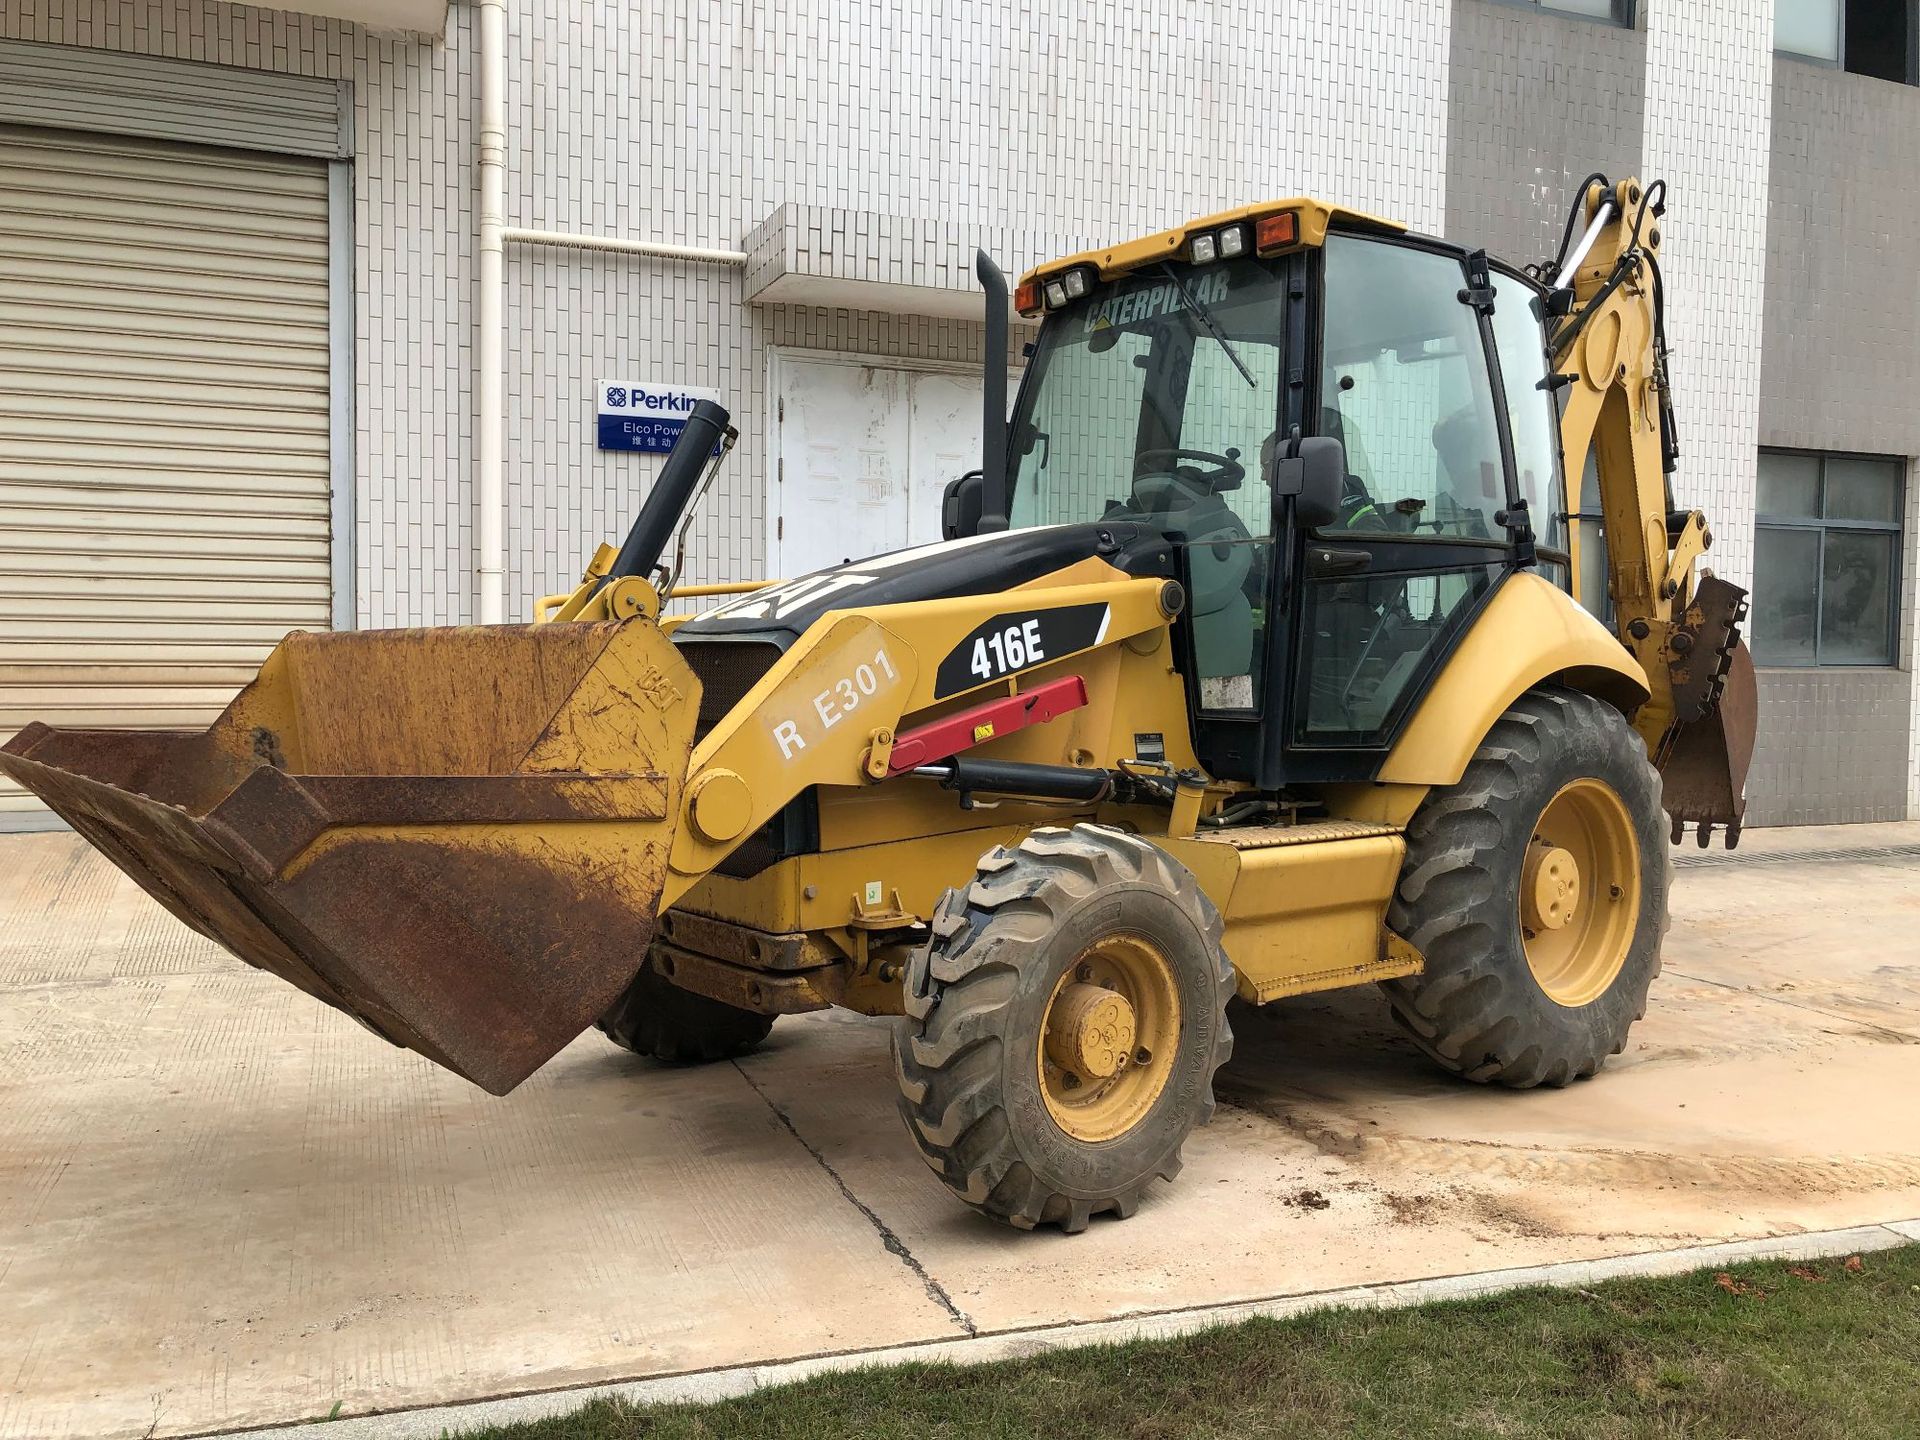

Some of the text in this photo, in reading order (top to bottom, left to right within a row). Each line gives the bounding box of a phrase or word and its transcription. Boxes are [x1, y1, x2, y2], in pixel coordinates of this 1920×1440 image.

[1084, 270, 1231, 333] CATERPILLAR
[623, 422, 685, 436] Elco Pow
[631, 389, 697, 411] Perkin
[971, 619, 1044, 679] 416E
[813, 649, 896, 729] E301
